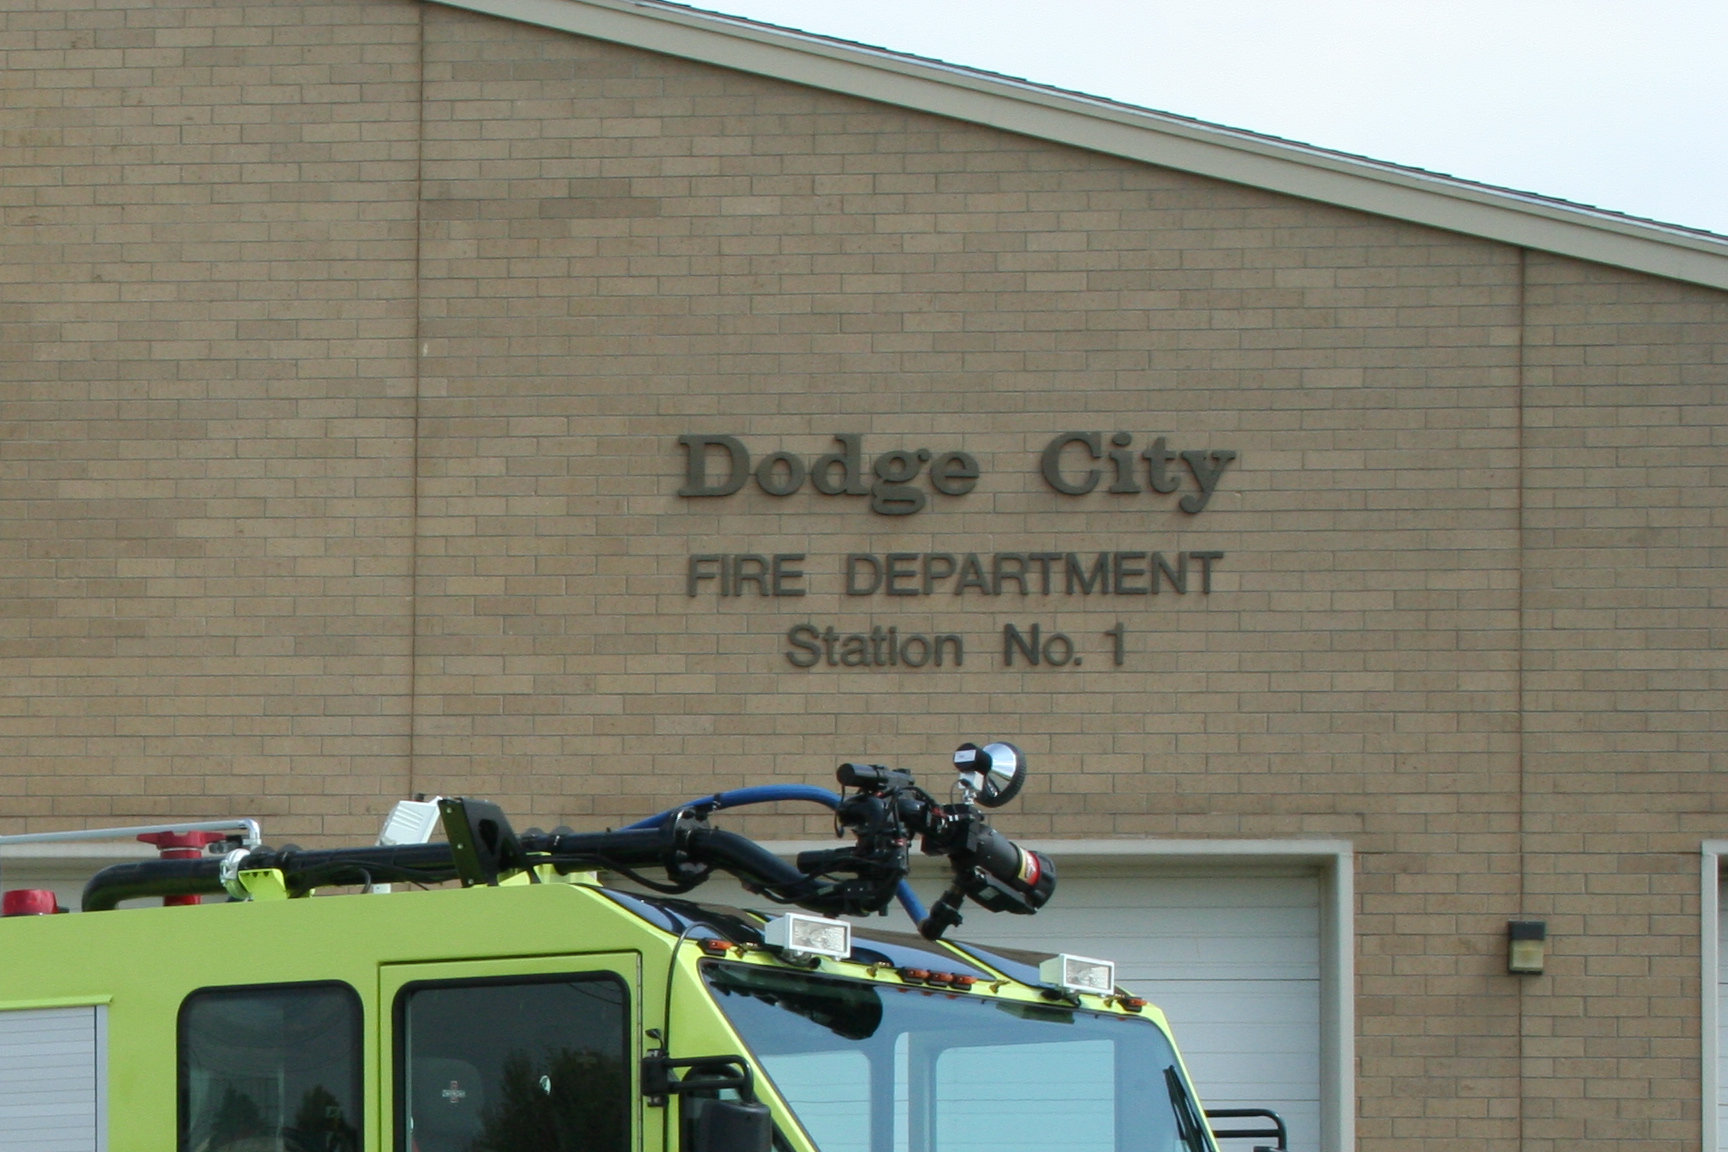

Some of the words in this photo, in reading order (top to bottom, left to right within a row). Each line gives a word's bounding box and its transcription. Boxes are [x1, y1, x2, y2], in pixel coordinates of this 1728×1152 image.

[677, 433, 980, 516] Dodge
[1040, 431, 1237, 514] City
[686, 553, 807, 598] FIRE
[846, 551, 1225, 598] DEPARTMENT
[785, 623, 964, 668] Station
[1003, 623, 1084, 667] No.
[1104, 622, 1125, 666] 1
